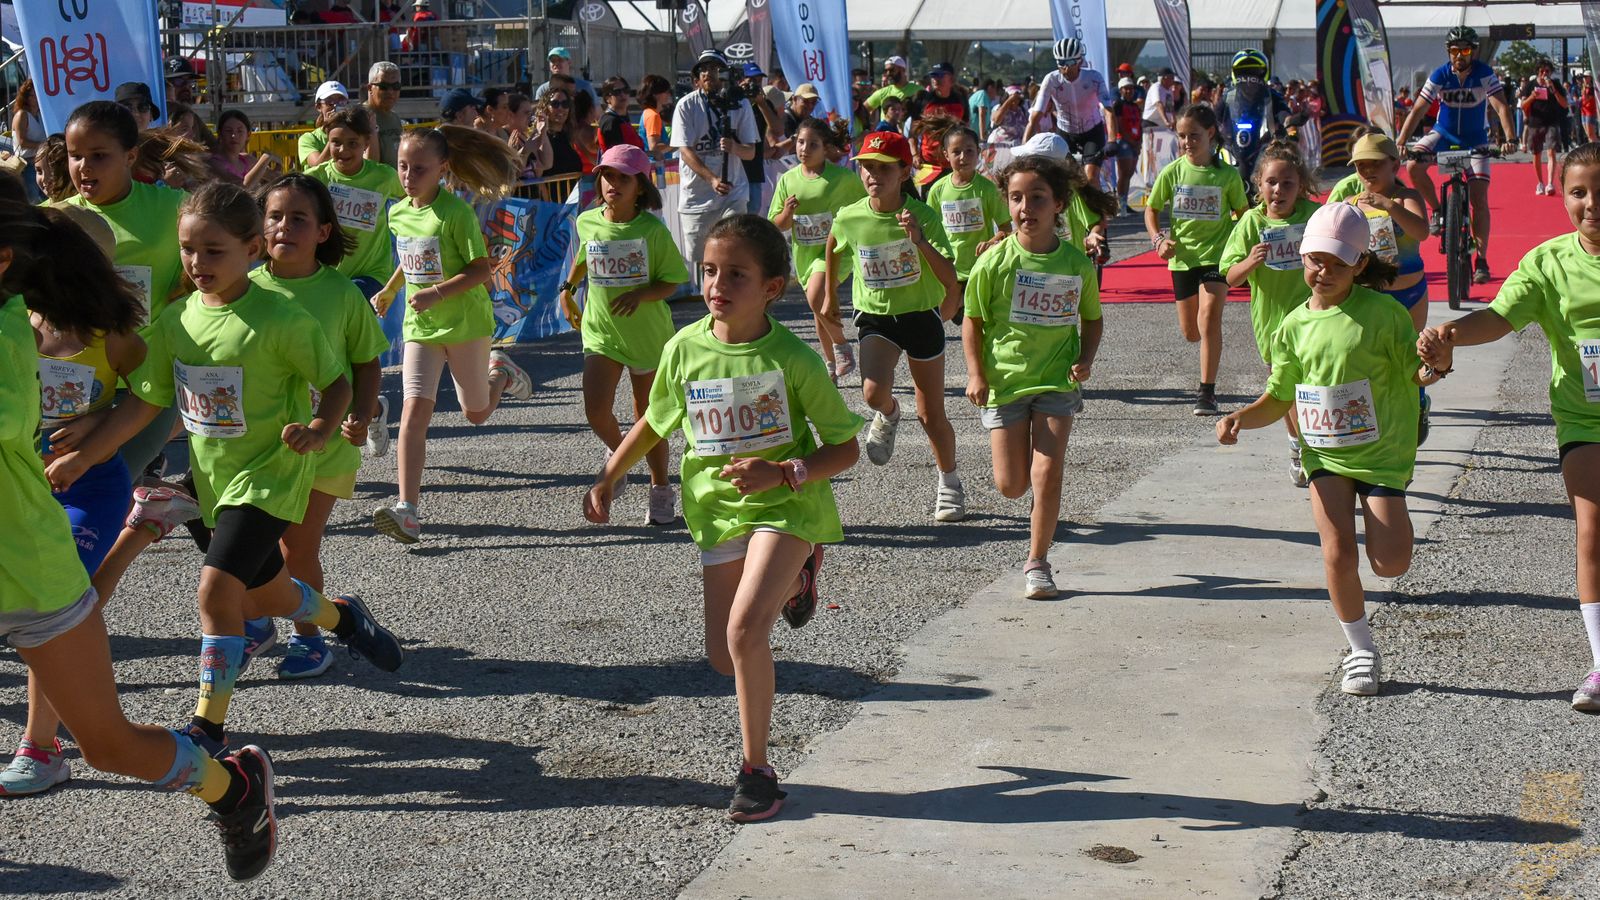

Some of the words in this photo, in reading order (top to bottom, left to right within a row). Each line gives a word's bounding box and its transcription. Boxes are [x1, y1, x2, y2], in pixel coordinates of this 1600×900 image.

[336, 199, 361, 217] 410
[1177, 196, 1205, 210] 1397
[945, 211, 968, 224] 1407
[797, 226, 820, 237] 1442
[591, 257, 627, 274] 1126
[863, 260, 900, 277] 1413
[1018, 289, 1063, 312] 1455
[1583, 345, 1598, 355] XXI
[690, 388, 705, 400] XXI
[695, 404, 754, 435] 1010
[1302, 407, 1346, 431] 1242
